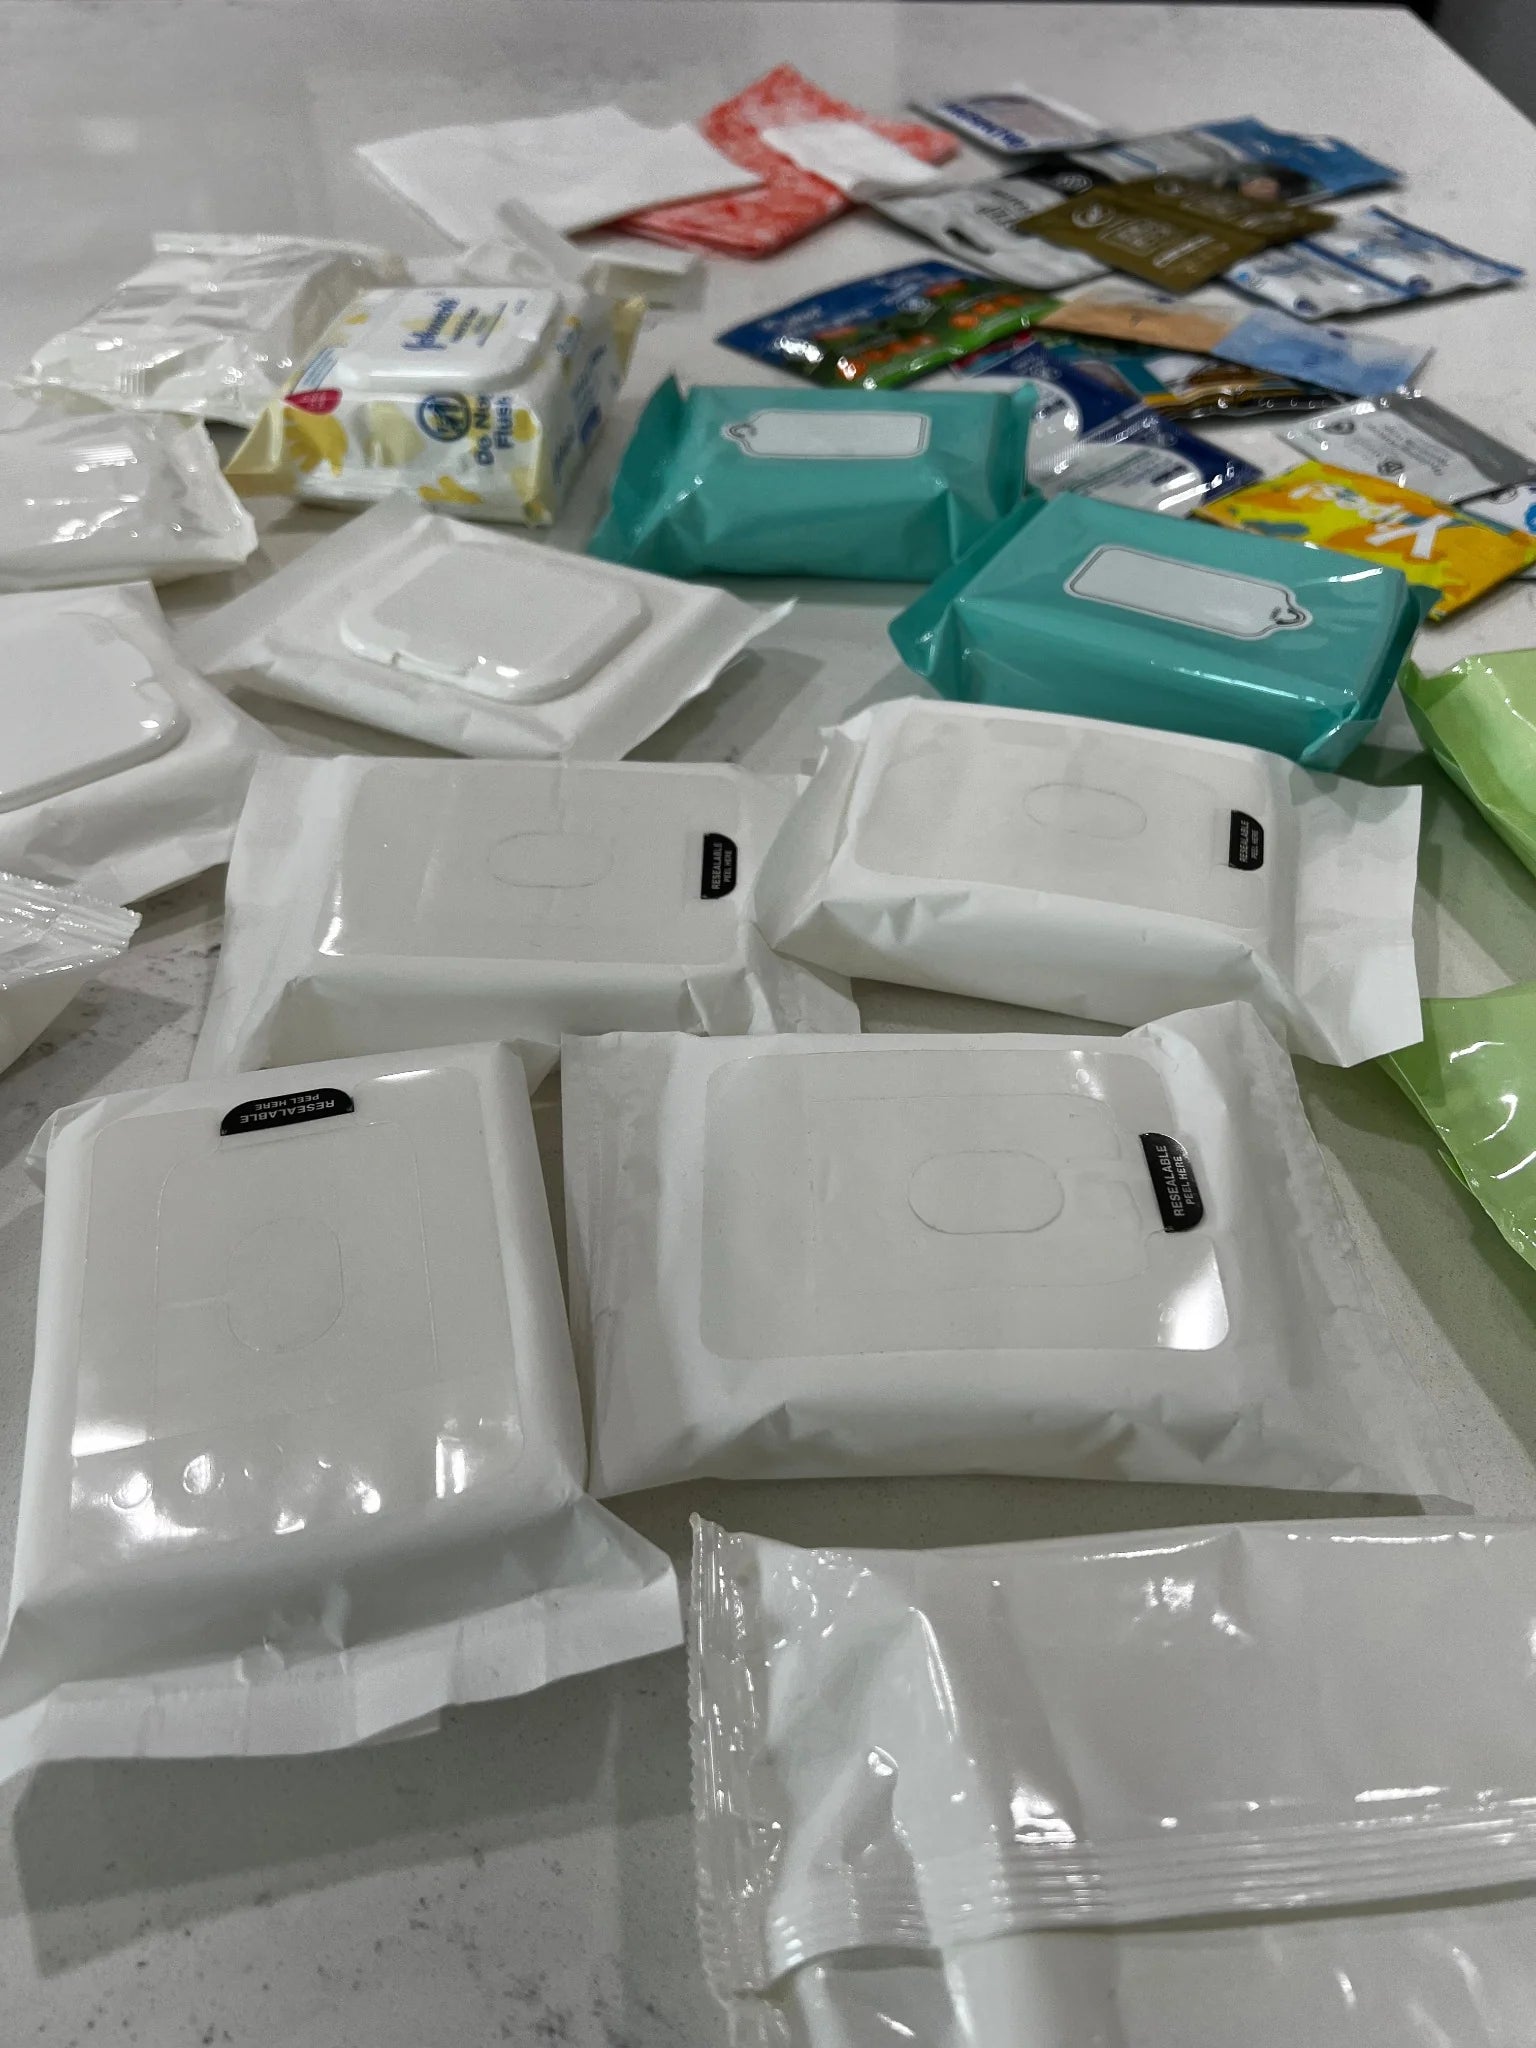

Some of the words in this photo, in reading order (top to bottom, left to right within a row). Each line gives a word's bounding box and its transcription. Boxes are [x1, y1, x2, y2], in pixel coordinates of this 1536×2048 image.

[493, 396, 514, 449] Flush
[474, 436, 494, 466] Do
[1239, 819, 1250, 863] RESEALABLE
[711, 841, 723, 890] RESEALABLE
[724, 849, 733, 867] HERE
[723, 867, 732, 883] PEEL
[254, 1099, 287, 1111] HERE
[289, 1093, 320, 1104] PEEL
[239, 1099, 335, 1124] RESEALABLE
[1173, 1156, 1189, 1180] HERE
[1155, 1144, 1186, 1217] RESEALABLE
[1181, 1181, 1196, 1205] PEEL
